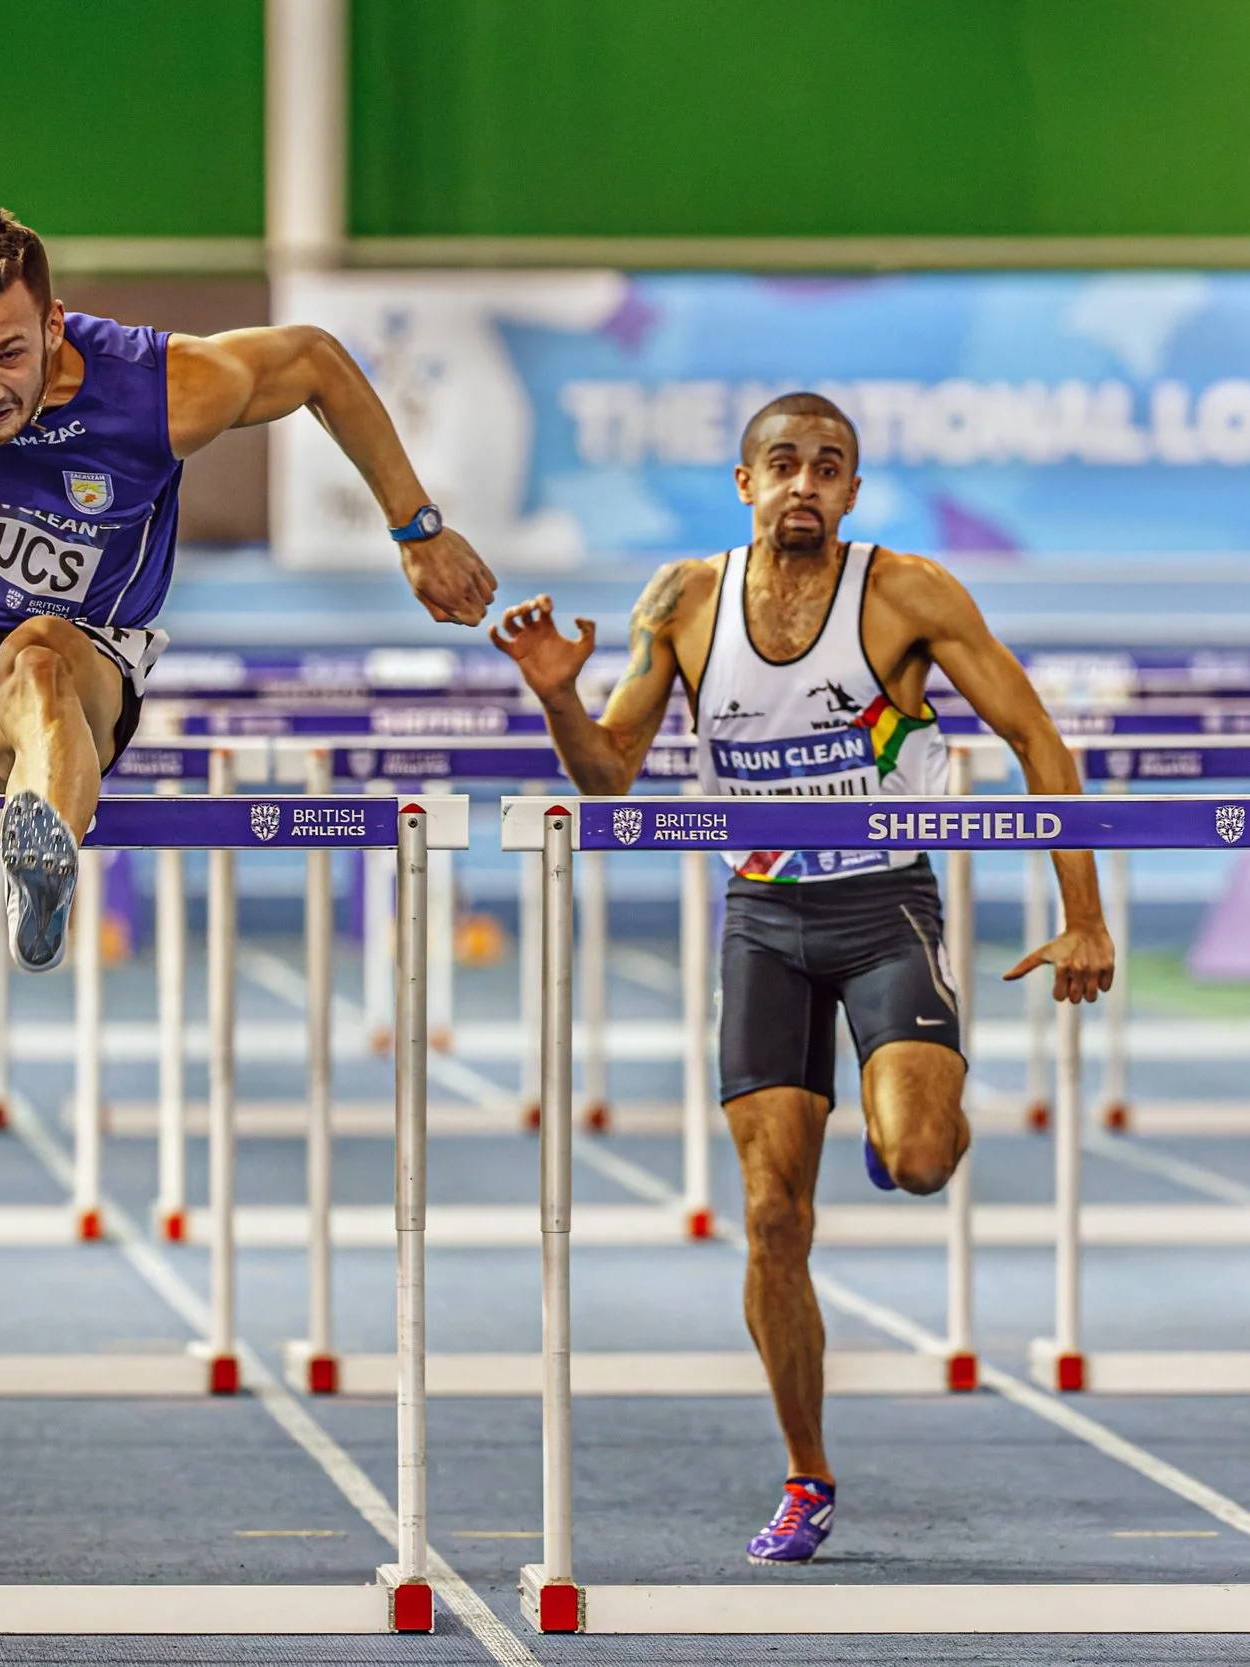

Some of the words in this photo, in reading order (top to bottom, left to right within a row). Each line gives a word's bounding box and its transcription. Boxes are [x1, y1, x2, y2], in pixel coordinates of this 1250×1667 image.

[562, 380, 728, 465] THE
[18, 506, 98, 537] LEAN
[28, 600, 71, 613] BRITISH
[718, 751, 728, 767] I
[731, 750, 781, 771] RUN
[785, 738, 866, 767] CLEAN
[293, 809, 365, 823] BRITISH
[655, 813, 727, 828] BRITISH
[291, 826, 366, 836] ATHLETICS
[867, 812, 1062, 840] SHEFFIELD
[654, 830, 728, 841] ATHLETICS
